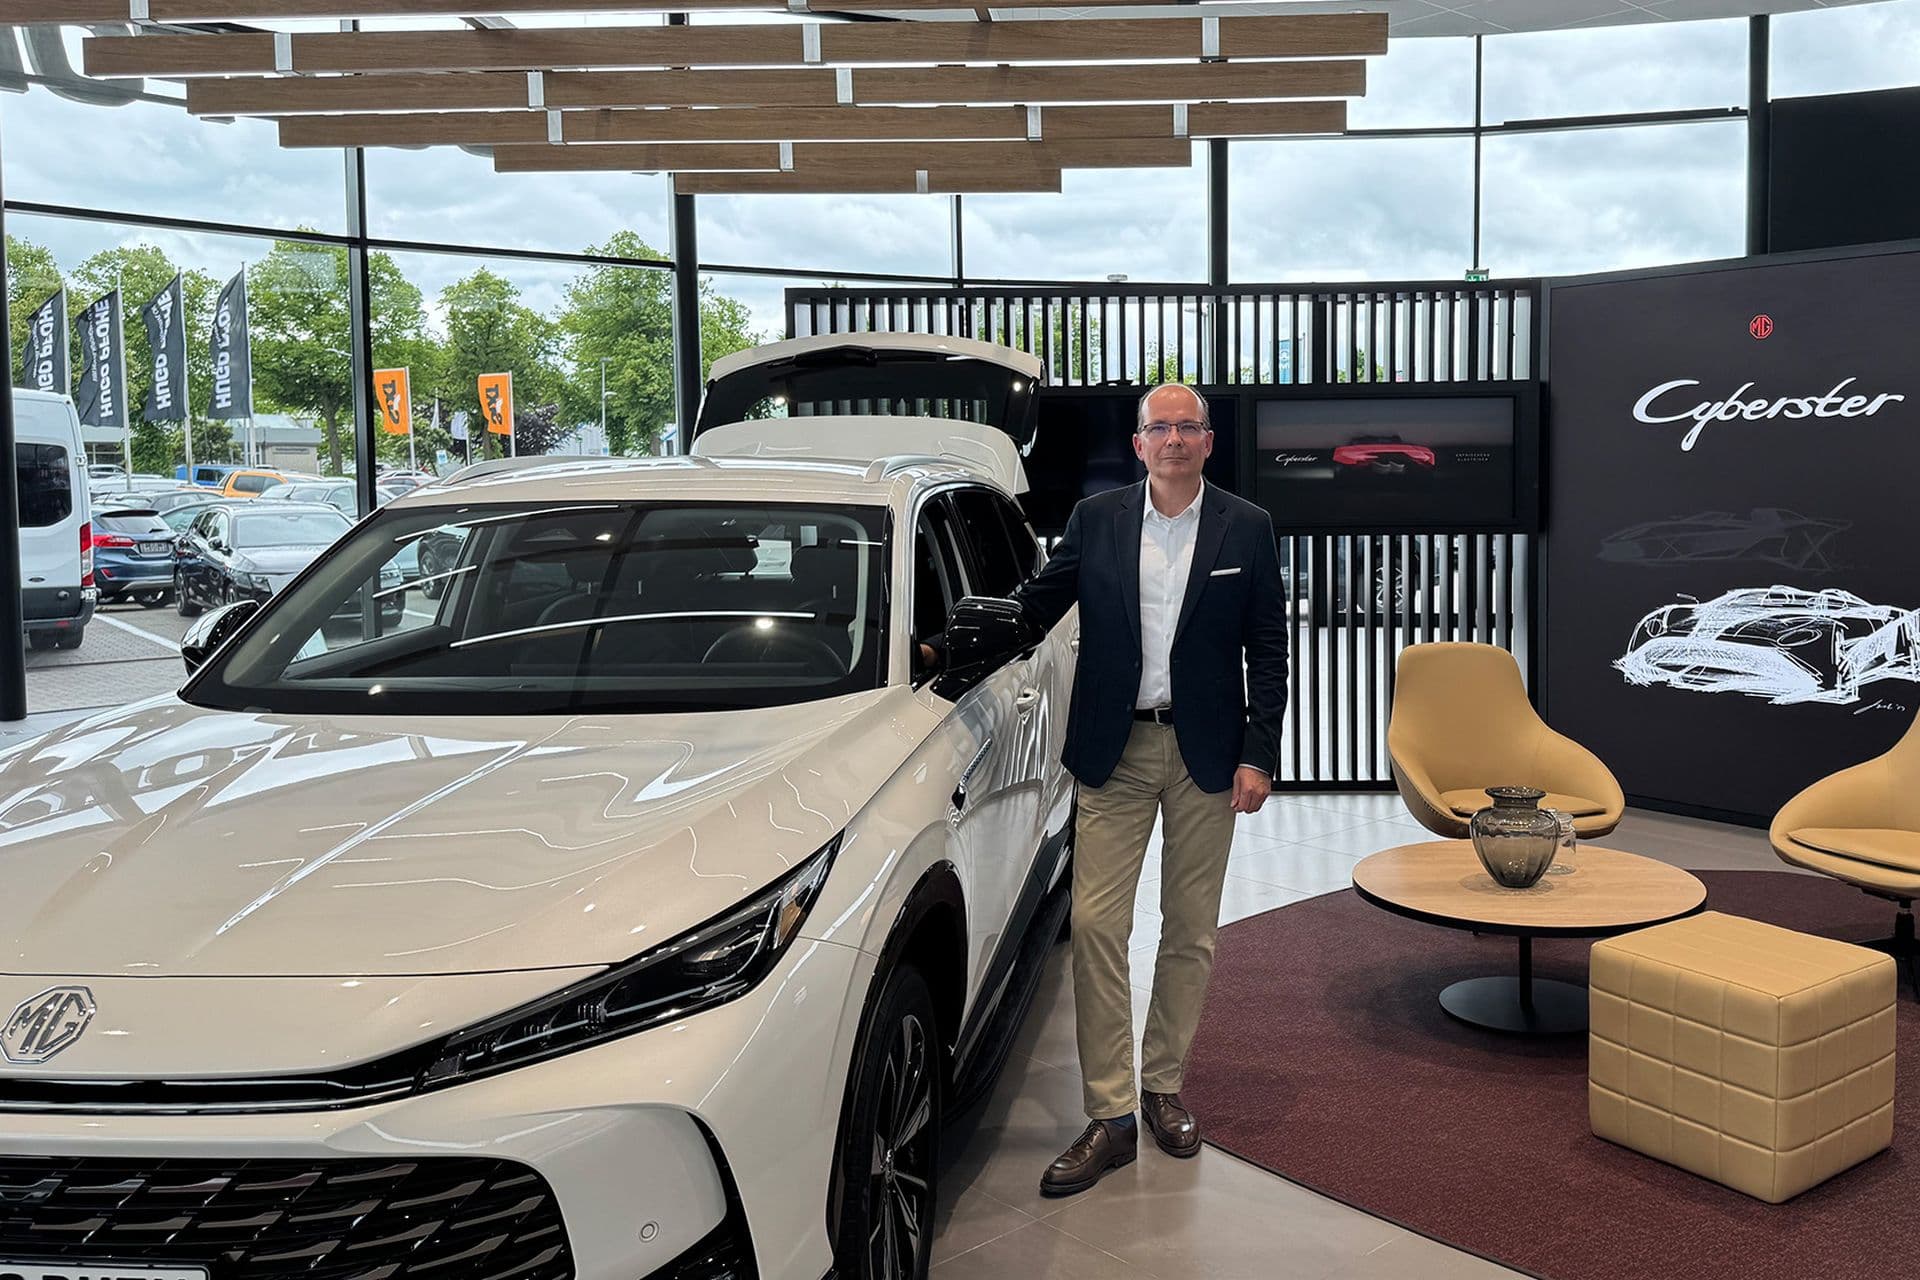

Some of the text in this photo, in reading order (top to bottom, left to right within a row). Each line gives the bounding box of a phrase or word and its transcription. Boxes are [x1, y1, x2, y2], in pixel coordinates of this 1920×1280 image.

[1751, 316, 1772, 338] MG
[1633, 377, 1905, 451] Cyberster
[7, 992, 87, 1054] MG
